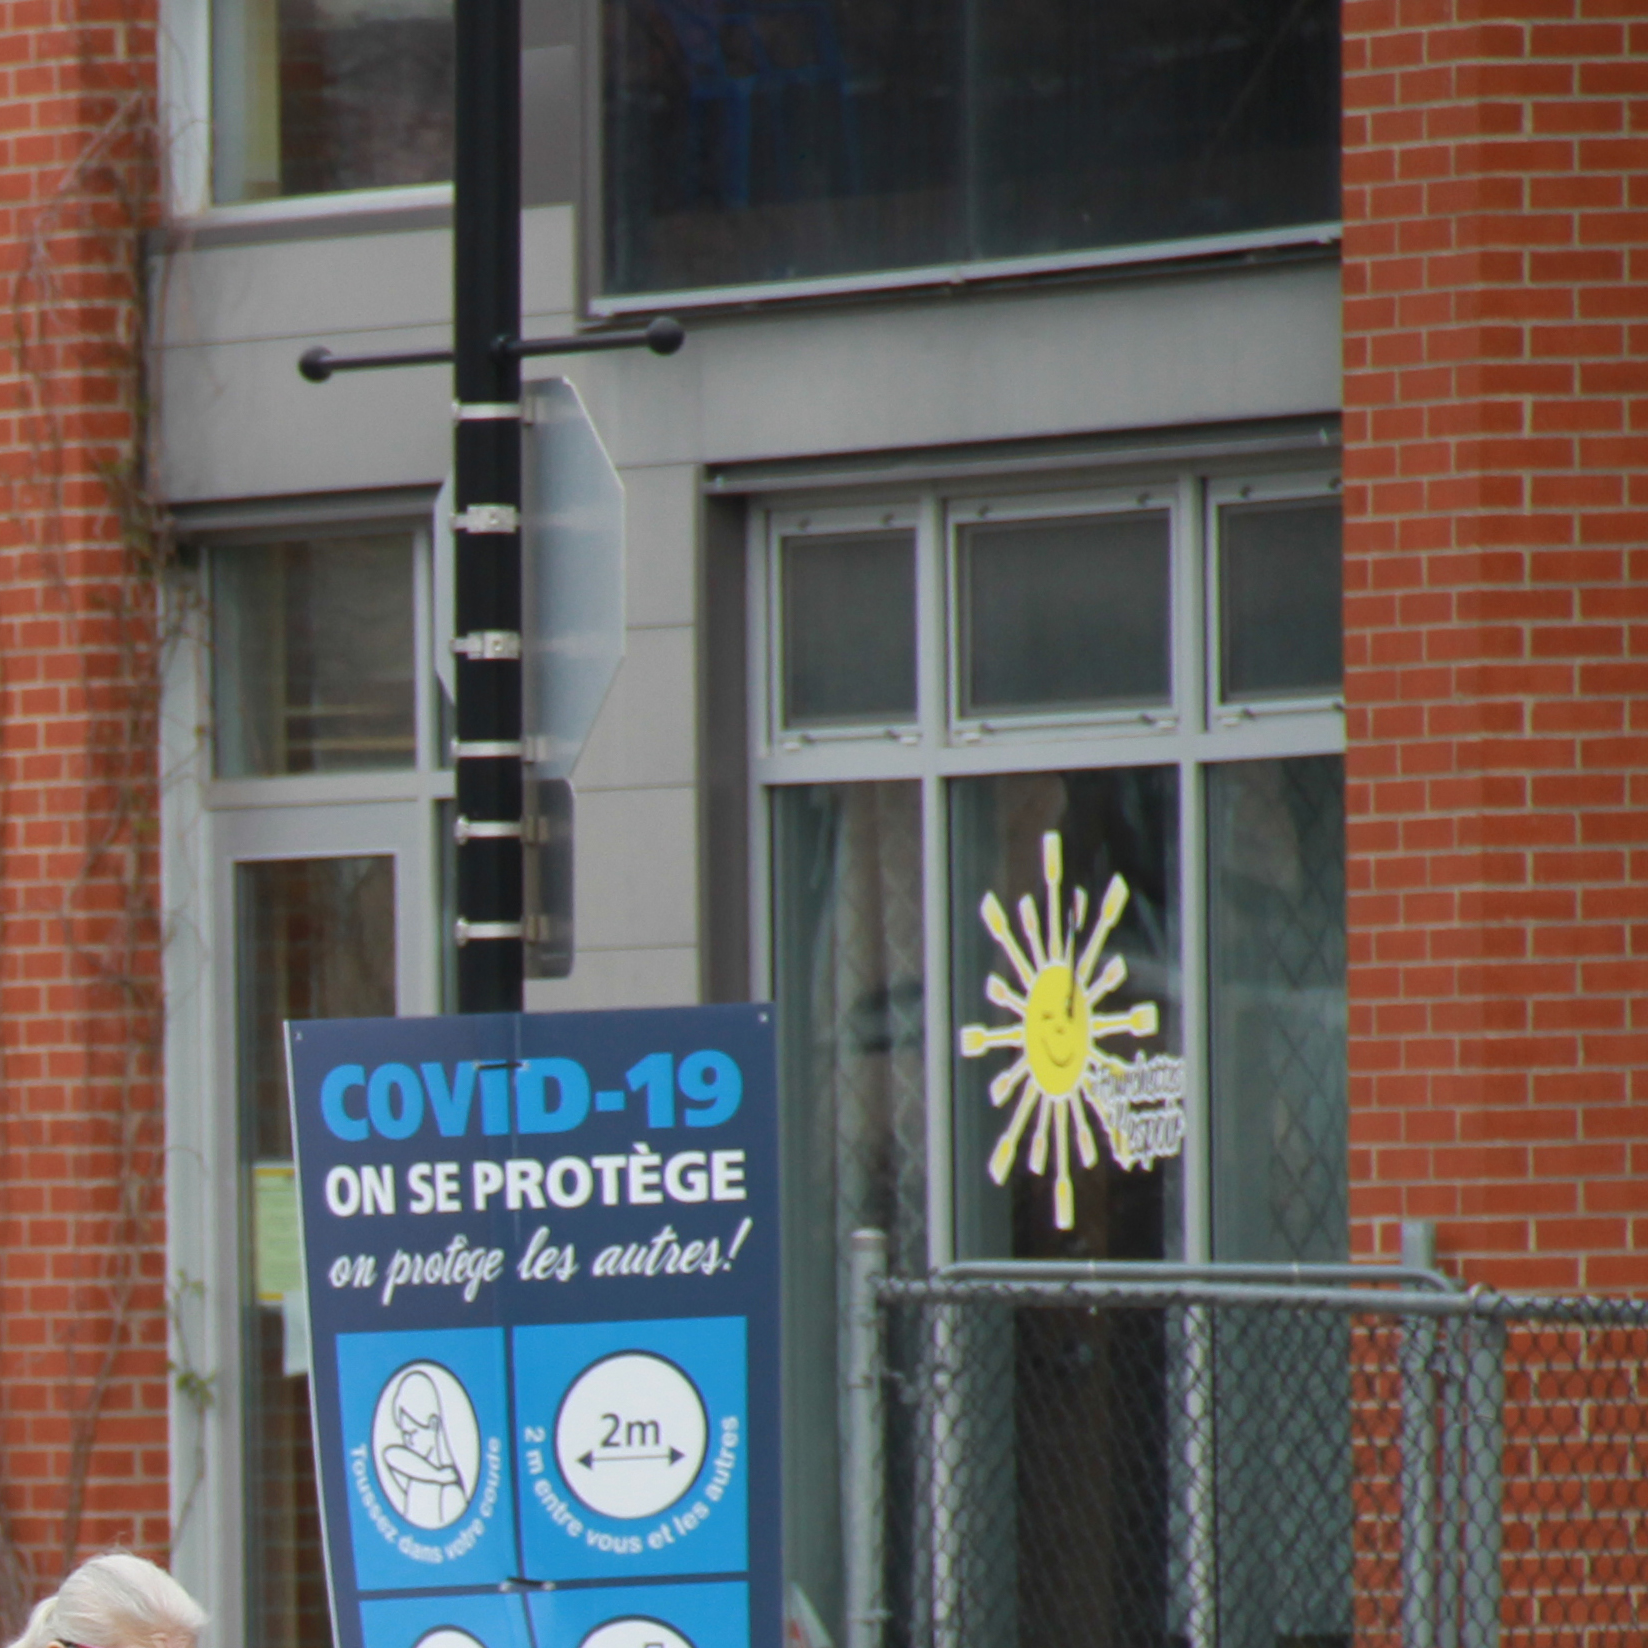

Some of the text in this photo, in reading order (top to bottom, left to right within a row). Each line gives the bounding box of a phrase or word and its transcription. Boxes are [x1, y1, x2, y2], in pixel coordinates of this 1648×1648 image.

[320, 1048, 743, 1142] COVID-19
[325, 1142, 747, 1217] ON SE PROTÈGE
[328, 1217, 753, 1306] on protège les autres!
[600, 1412, 661, 1449] 2m
[350, 1436, 500, 1564] Toussez dans votre coude
[523, 1415, 740, 1555] 2 m entre vous et les autres
